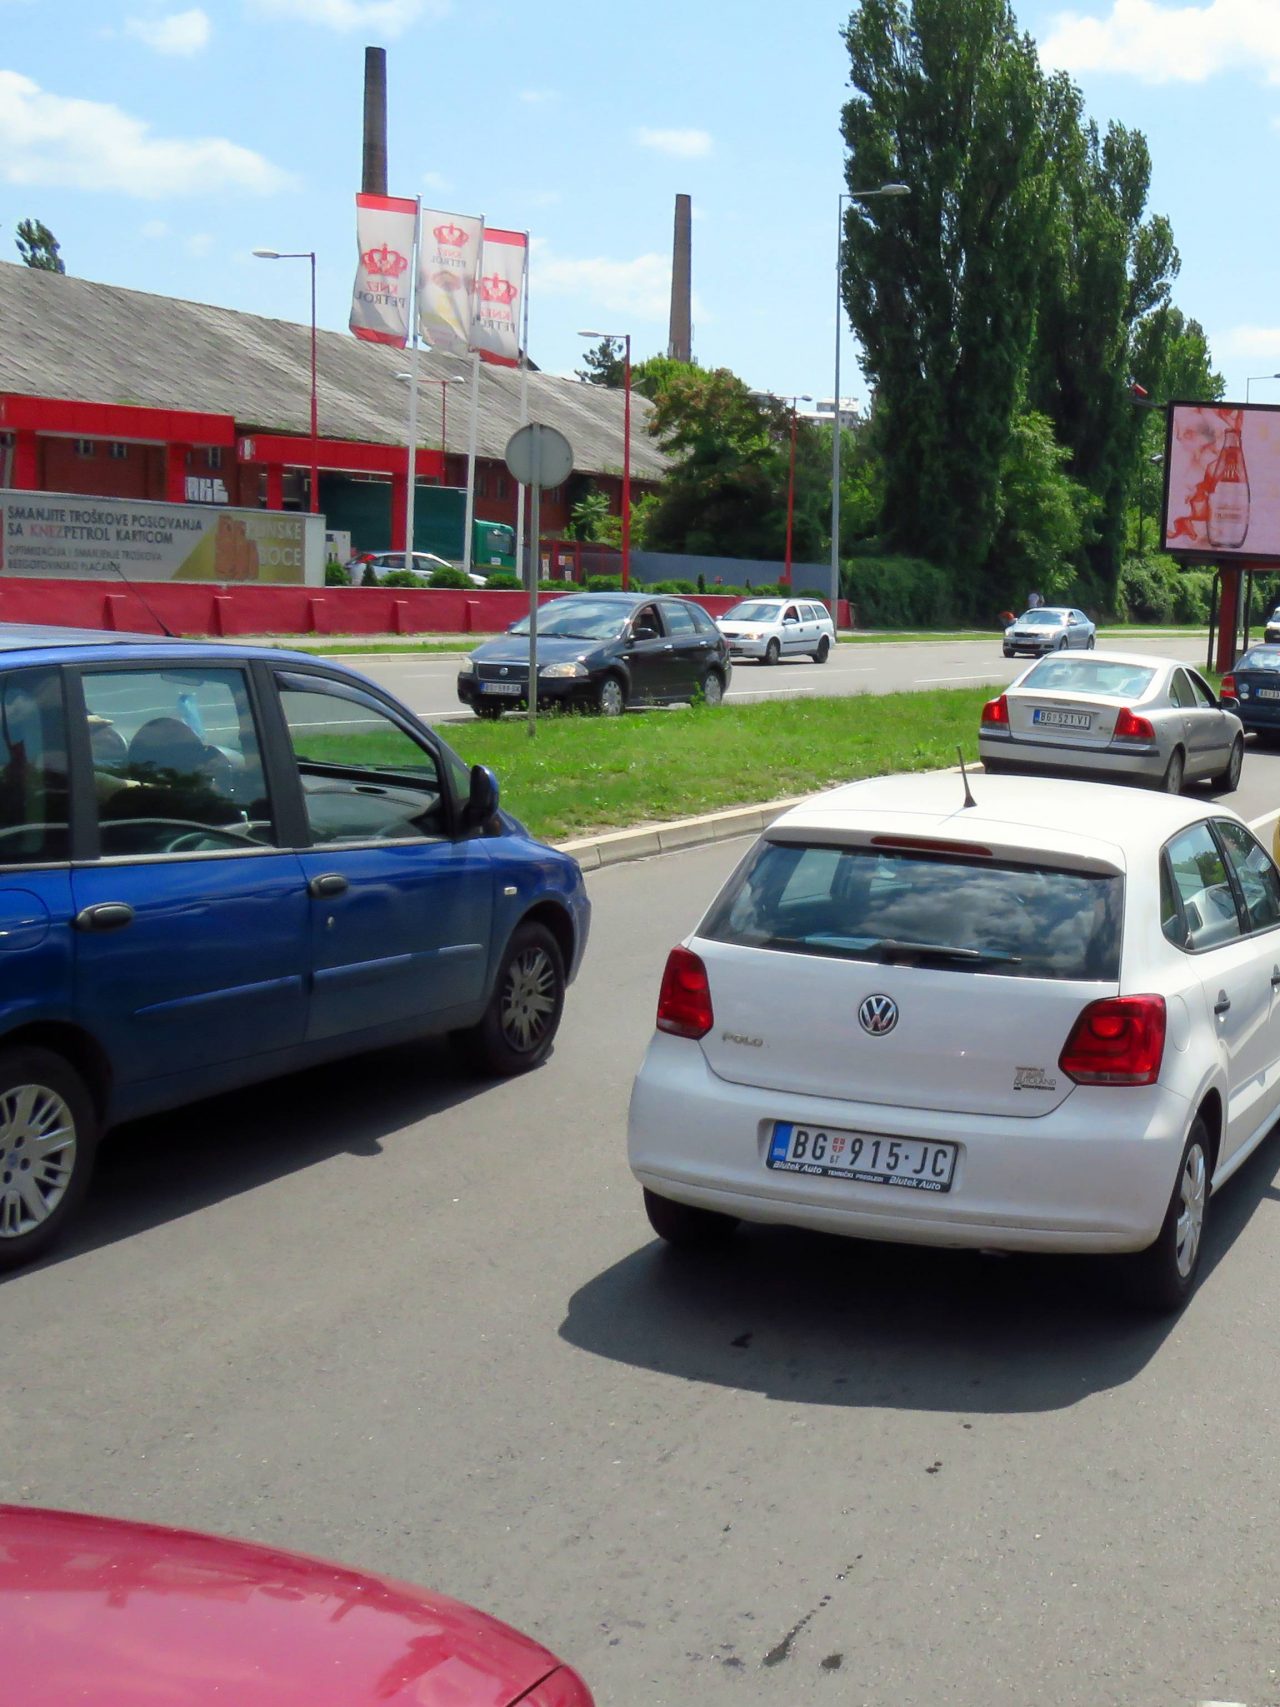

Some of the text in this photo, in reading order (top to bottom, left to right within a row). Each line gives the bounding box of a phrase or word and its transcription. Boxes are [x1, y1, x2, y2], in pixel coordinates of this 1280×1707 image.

[8, 506, 202, 530] SMANJITE TROŠKOVE POSLOVANJA
[8, 523, 23, 536] SA
[116, 529, 173, 543] KARTICOM
[1040, 711, 1051, 723] BG
[792, 1130, 828, 1161] BG
[800, 1164, 823, 1174] Auto
[918, 1180, 941, 1191] Auto
